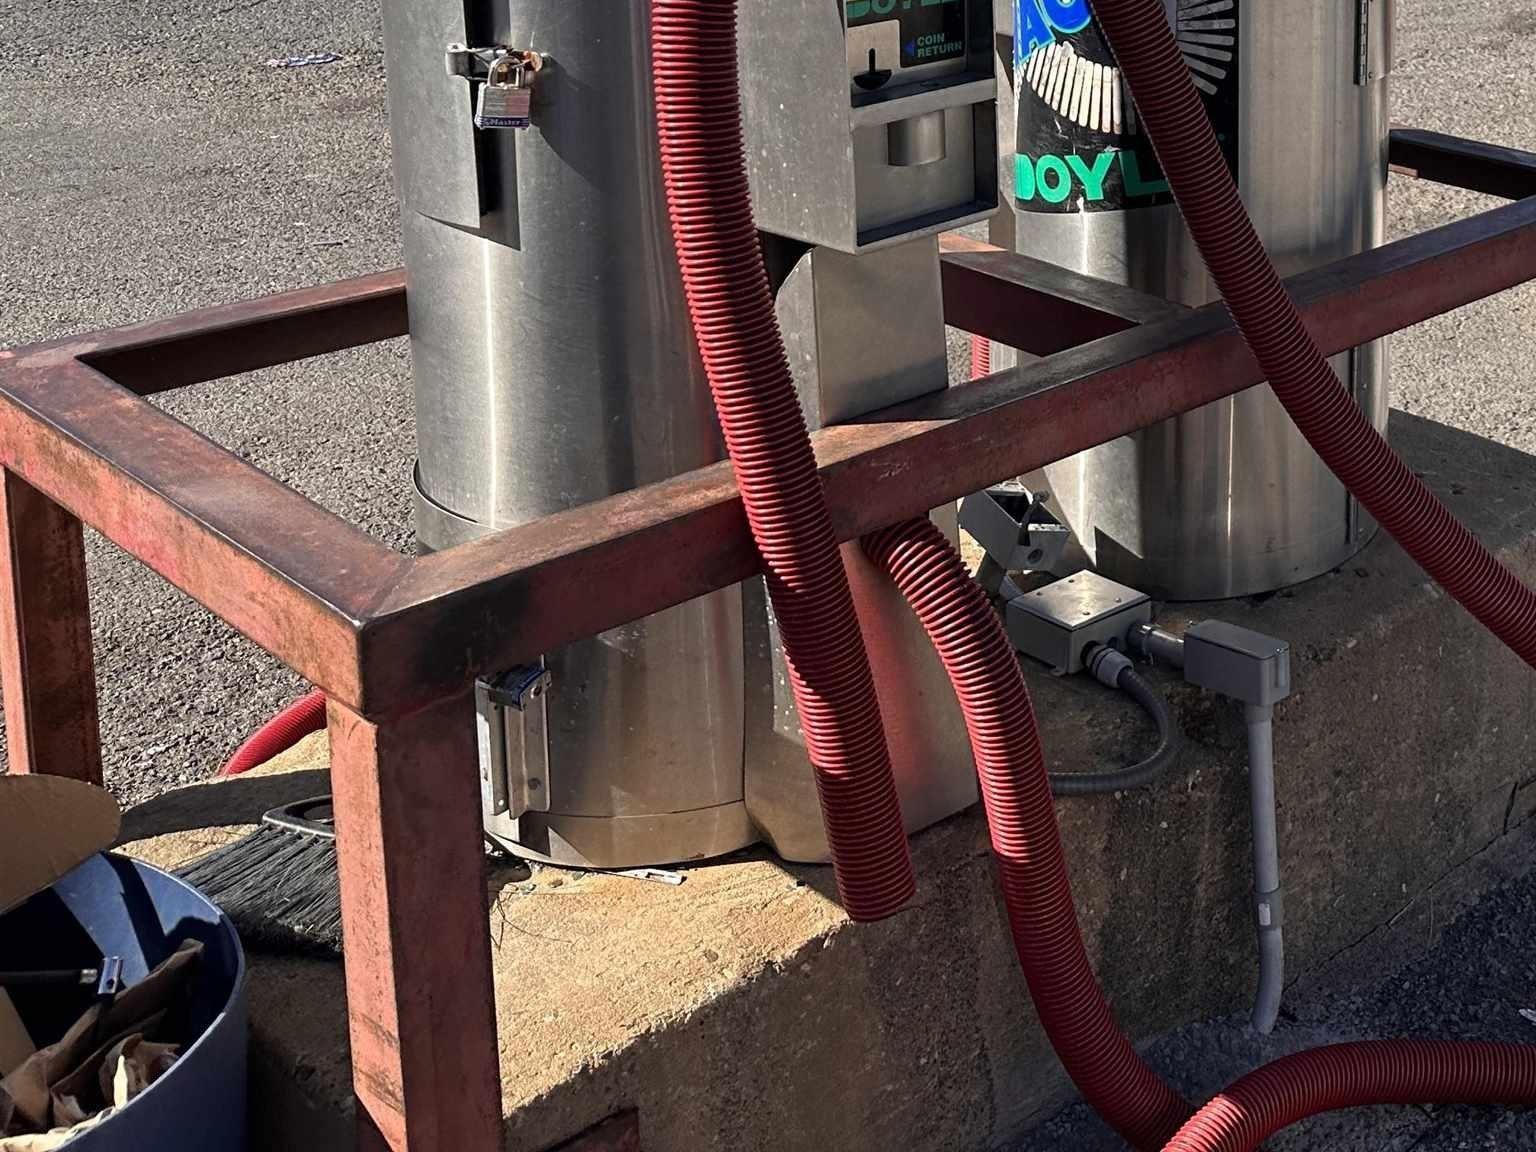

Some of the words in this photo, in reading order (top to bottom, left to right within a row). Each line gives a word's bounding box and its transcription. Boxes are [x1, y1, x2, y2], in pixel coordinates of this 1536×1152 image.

[917, 33, 945, 46] COIN
[917, 41, 962, 58] RETURN
[1015, 150, 1170, 203] DOYL
